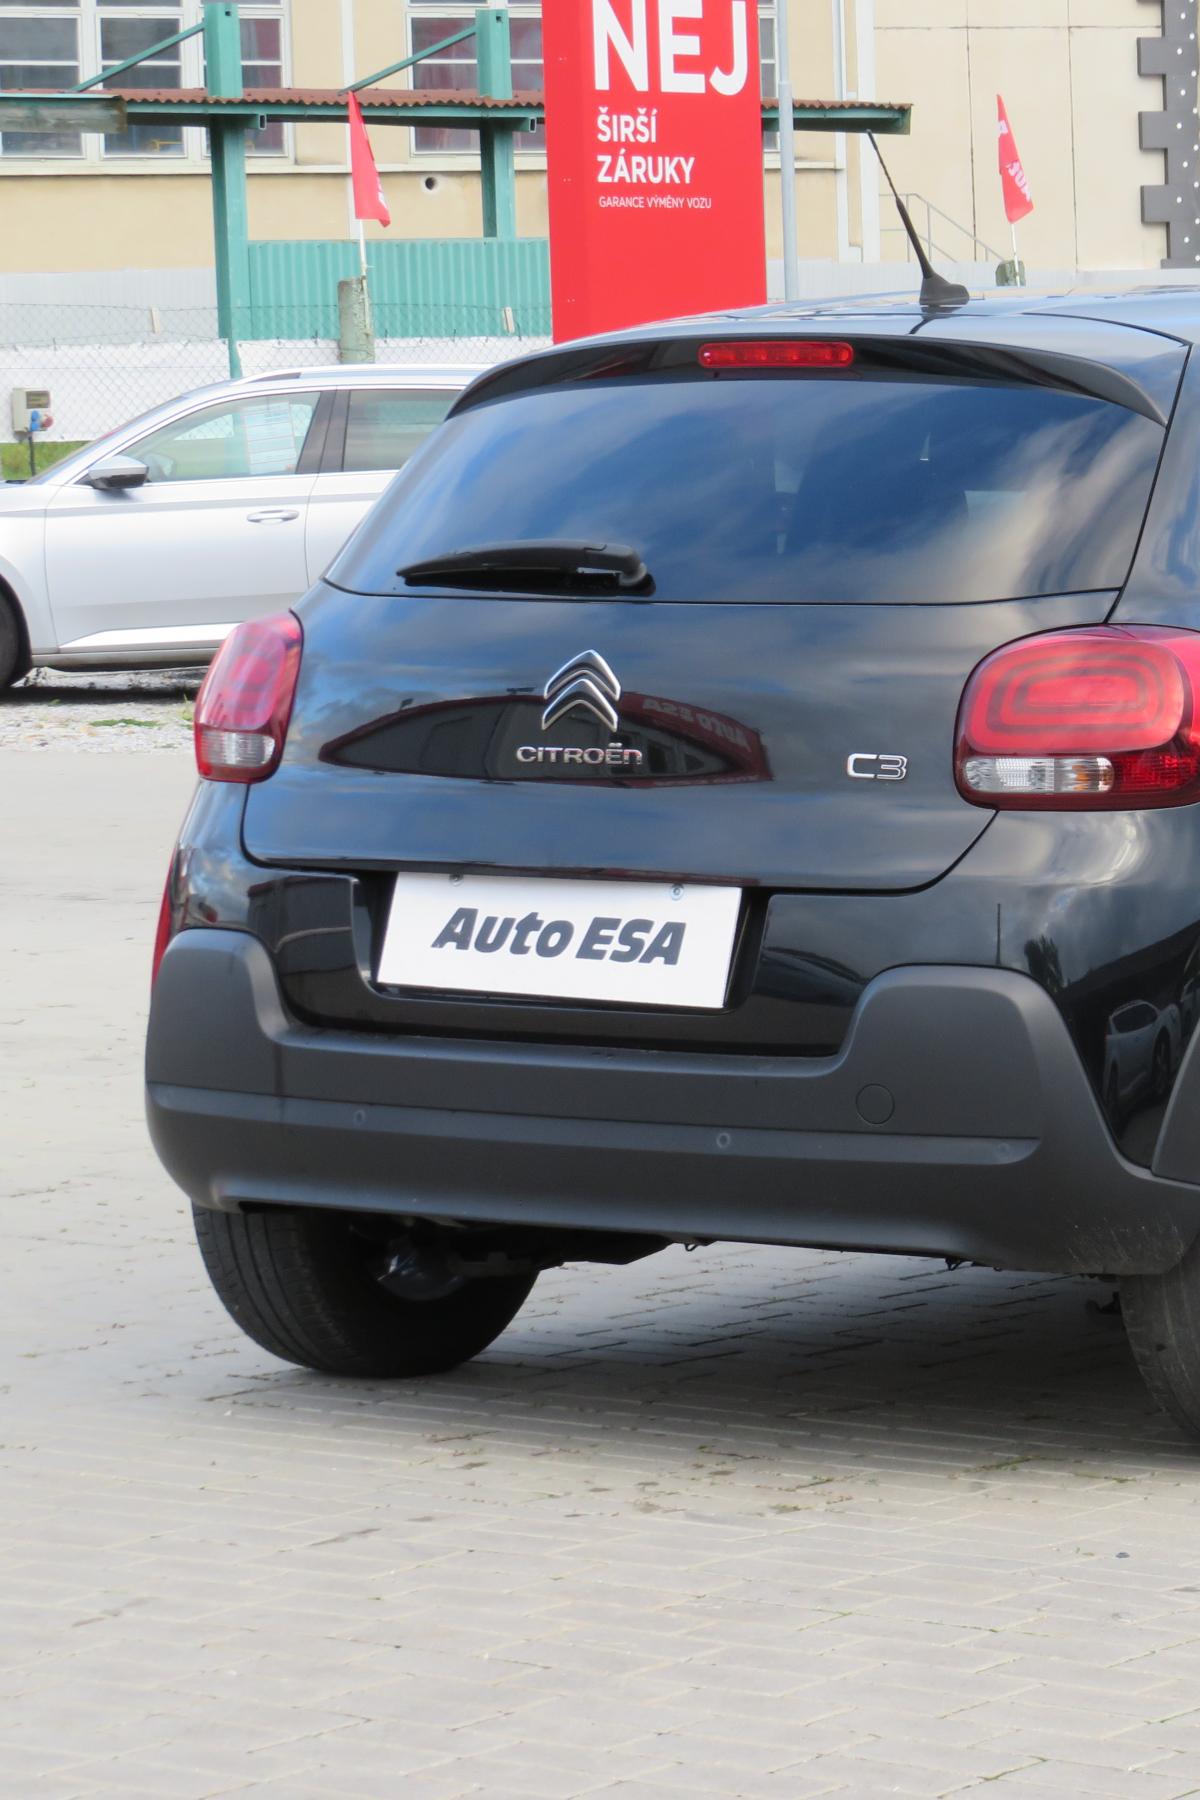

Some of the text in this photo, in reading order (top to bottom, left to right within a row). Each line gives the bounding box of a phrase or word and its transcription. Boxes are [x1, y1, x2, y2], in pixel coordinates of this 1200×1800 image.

[592, 0, 748, 96] NEJ
[596, 106, 658, 143] ŠIRŠÍ
[596, 148, 695, 184] ZÁRUKY
[598, 194, 712, 209] GARANCE VÝMĚNY VOZU
[846, 752, 909, 782] C3
[431, 906, 687, 966] Auto ESA
